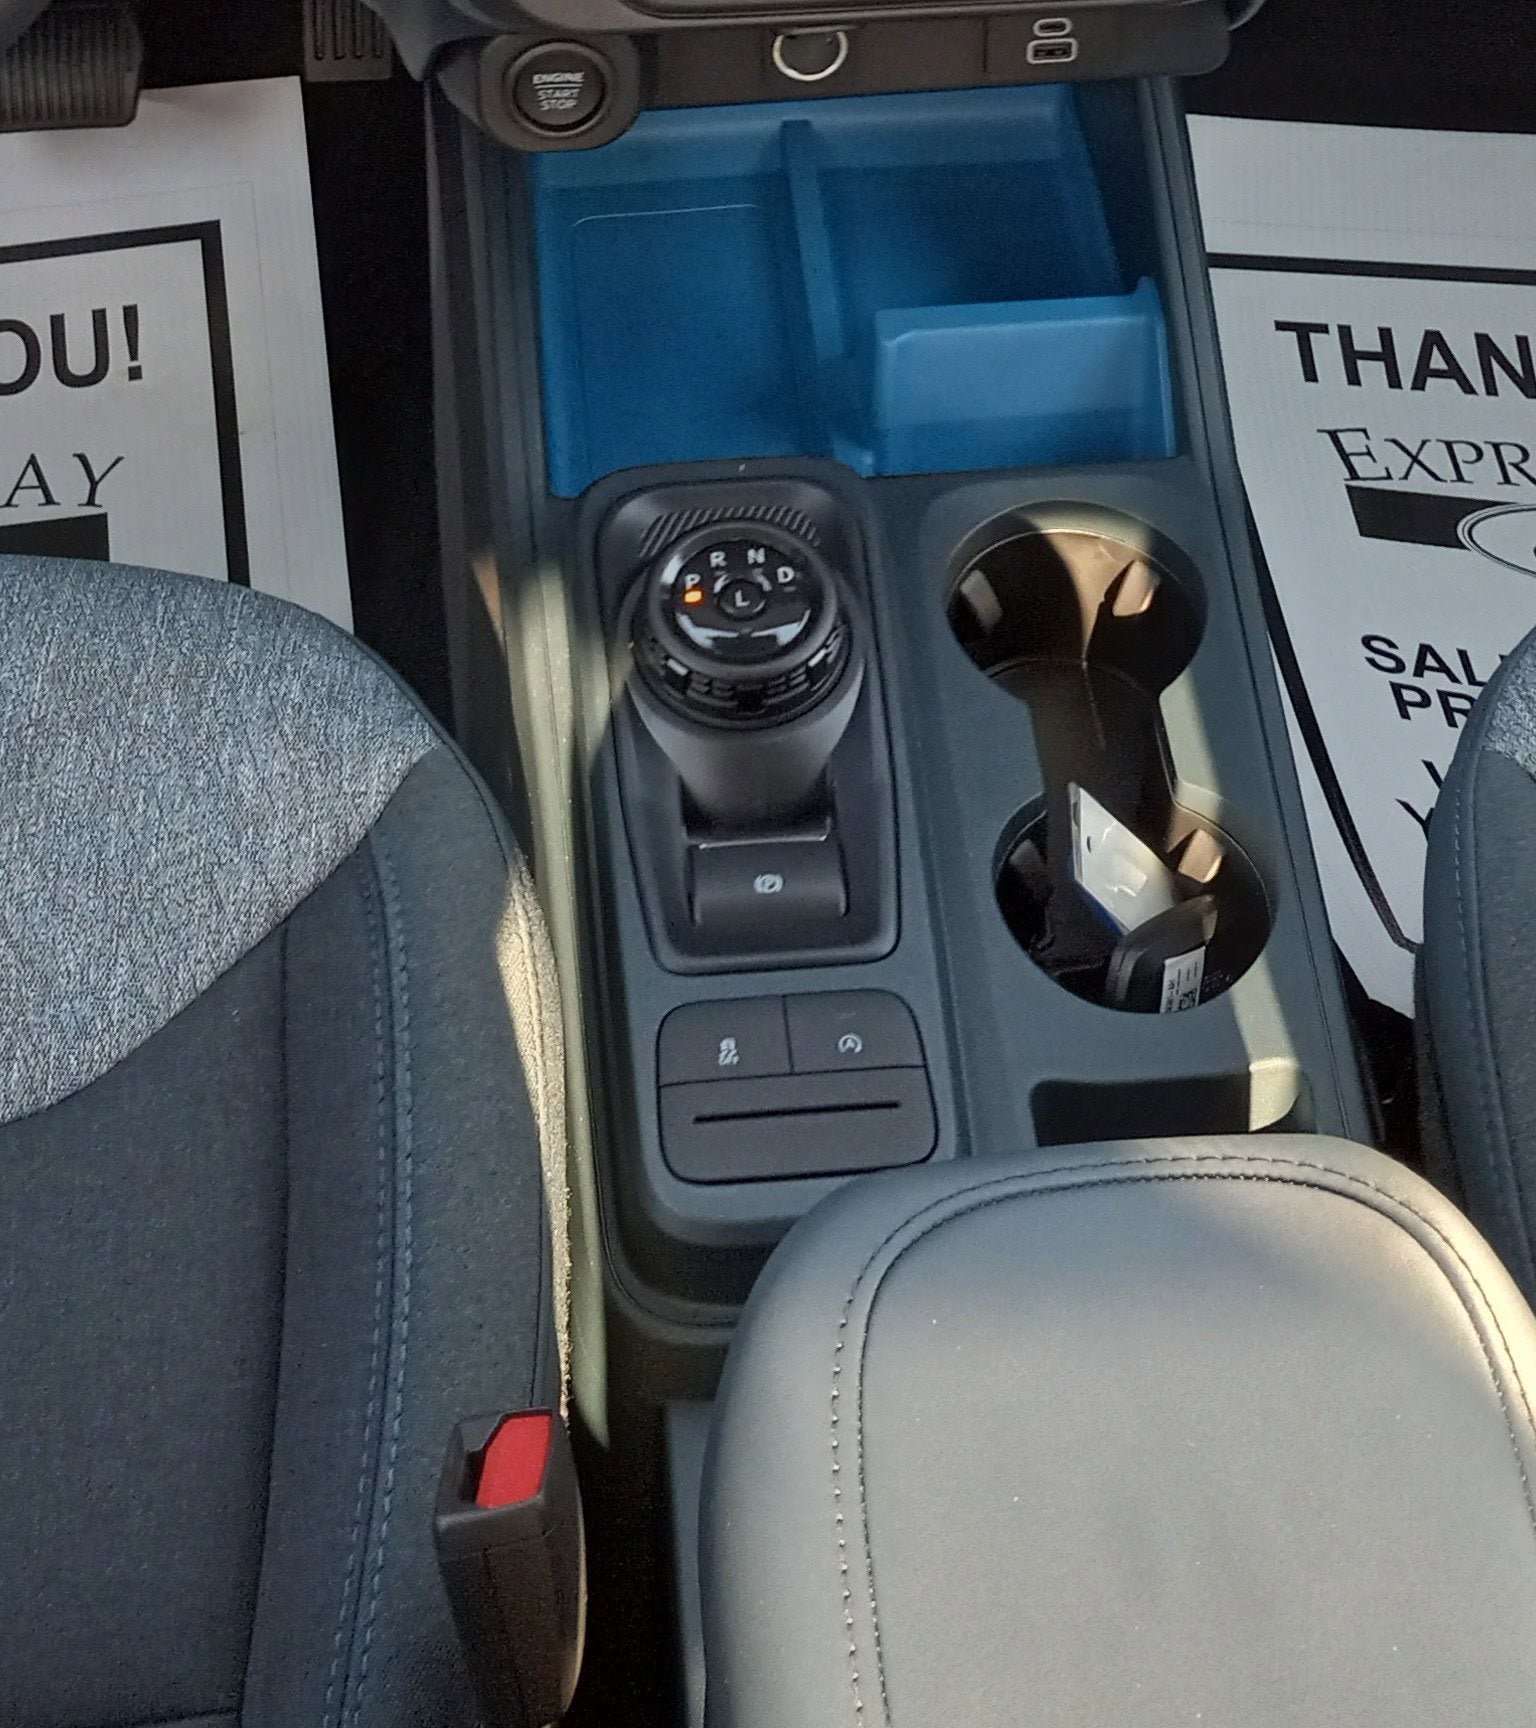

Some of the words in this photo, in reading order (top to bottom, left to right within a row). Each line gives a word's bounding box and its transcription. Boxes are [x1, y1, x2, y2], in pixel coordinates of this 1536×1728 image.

[532, 71, 586, 85] ENGINE
[537, 87, 581, 102] START
[540, 99, 579, 112] STOP
[710, 550, 728, 568] R
[747, 547, 766, 565] N
[777, 566, 795, 584] D
[735, 589, 751, 607] L
